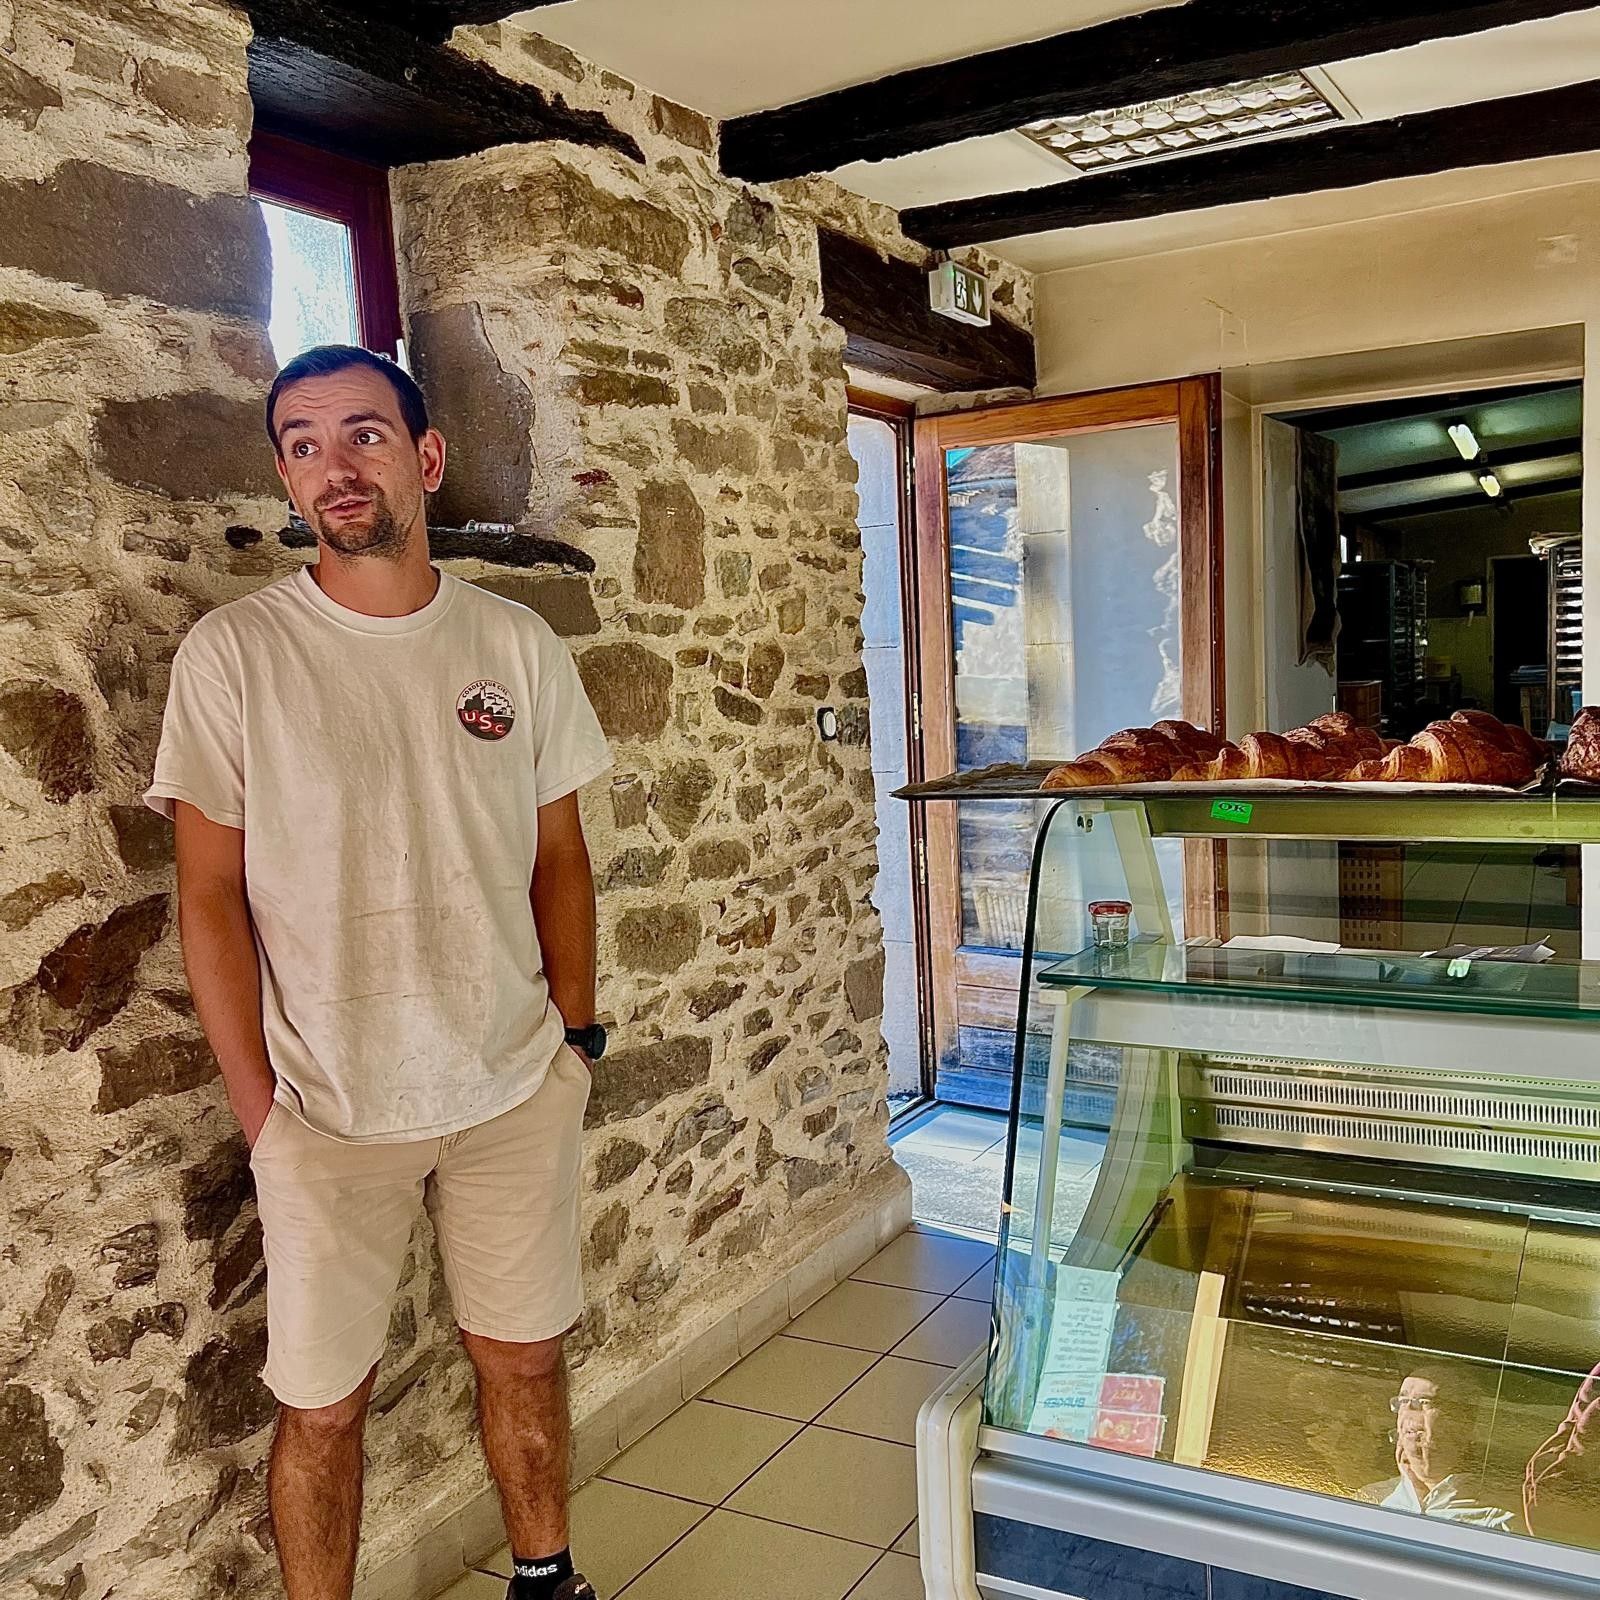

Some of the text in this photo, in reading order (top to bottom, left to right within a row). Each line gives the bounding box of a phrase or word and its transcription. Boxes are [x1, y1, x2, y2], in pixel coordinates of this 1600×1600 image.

[497, 685, 508, 696] CIEL
[464, 711, 503, 733] USC
[1218, 802, 1247, 814] OK
